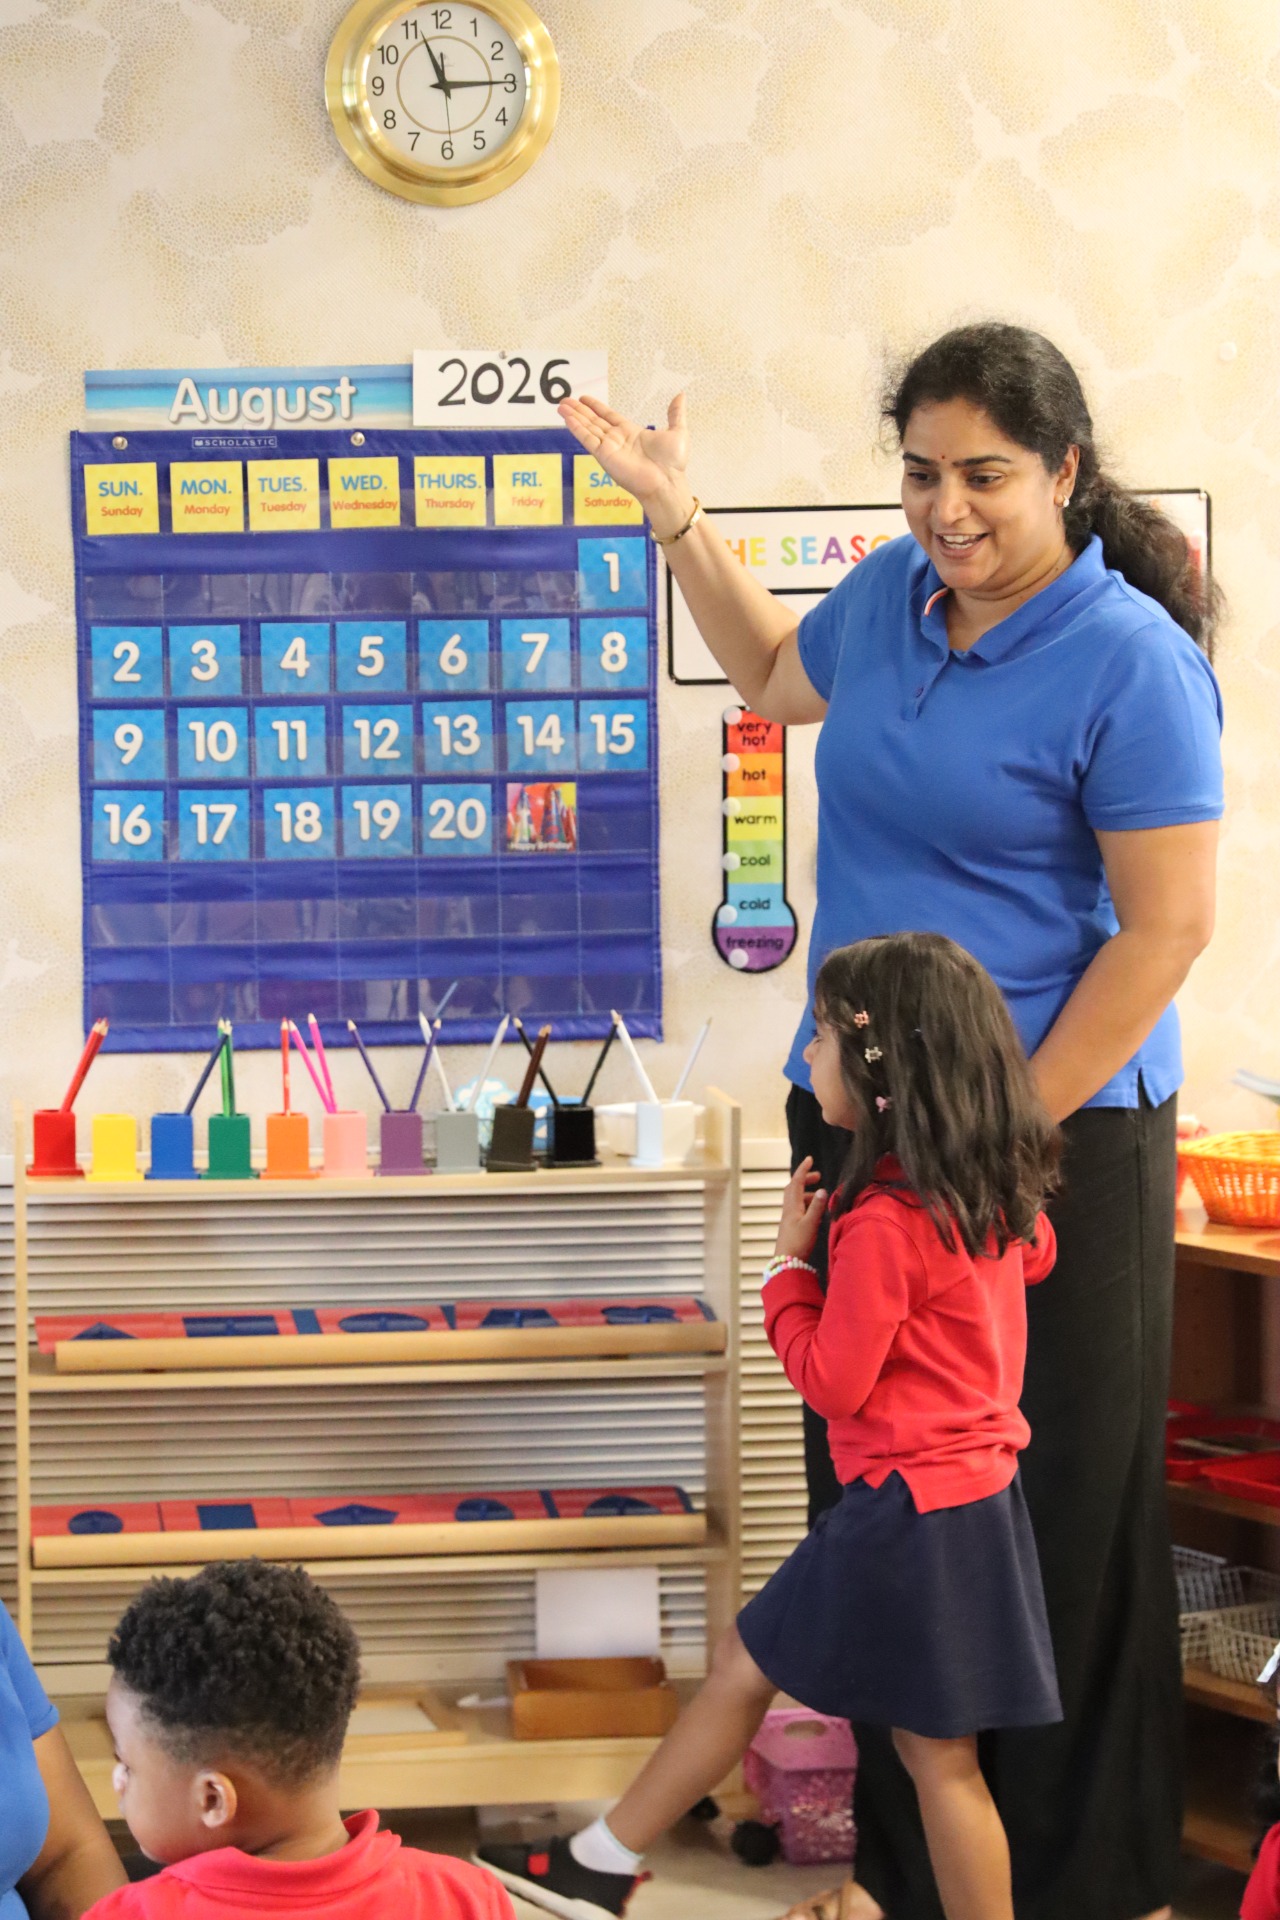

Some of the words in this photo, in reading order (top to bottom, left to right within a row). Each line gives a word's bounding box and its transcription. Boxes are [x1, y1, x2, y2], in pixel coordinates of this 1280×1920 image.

[431, 9, 452, 30] 12
[470, 18, 478, 38] 1
[401, 20, 419, 40] 11
[377, 44, 399, 65] 10
[491, 41, 504, 61] 2
[371, 76, 385, 97] 9
[503, 73, 517, 93] 3
[383, 109, 397, 130] 8
[495, 107, 509, 126] 4
[407, 132, 421, 151] 7
[441, 140, 454, 160] 6
[473, 130, 486, 151] 5
[437, 357, 572, 407] 2026
[168, 376, 357, 430] August
[204, 437, 276, 447] SCHOLASTIC
[98, 480, 143, 498] SUN.
[180, 479, 232, 496] MON.
[257, 476, 308, 493] TUES.
[340, 474, 388, 491] WED.
[417, 473, 482, 489] THURS.
[512, 471, 543, 488] FRI.
[589, 472, 613, 488] SA
[100, 505, 143, 518] Sunday
[184, 503, 231, 517] Monday
[260, 500, 307, 514] Tuesday
[332, 498, 399, 511] Wednesday
[425, 498, 475, 511] Thursday
[511, 496, 545, 509] Friday
[584, 496, 633, 509] Saturday
[725, 537, 767, 566] HE
[603, 552, 620, 593] 1
[112, 641, 142, 682] 2
[190, 639, 220, 681] 3
[279, 637, 311, 678] 4
[356, 635, 385, 677] 5
[439, 633, 468, 675] 6
[521, 632, 550, 674] 7
[600, 631, 628, 673] 8
[433, 714, 481, 756] 13
[516, 714, 565, 756] 14
[590, 713, 636, 755] 15
[736, 722, 772, 735] very
[113, 723, 144, 765] 9
[188, 720, 238, 762] 10
[271, 720, 307, 761] 11
[353, 718, 402, 760] 12
[742, 734, 766, 746] hot
[742, 768, 767, 781] hot
[103, 803, 152, 846] 16
[190, 803, 238, 845] 17
[274, 801, 323, 843] 18
[353, 799, 401, 841] 19
[429, 798, 487, 840] 20
[733, 814, 778, 825] warm
[739, 855, 771, 867] cool
[739, 898, 771, 910] cold
[726, 935, 784, 950] freezing
